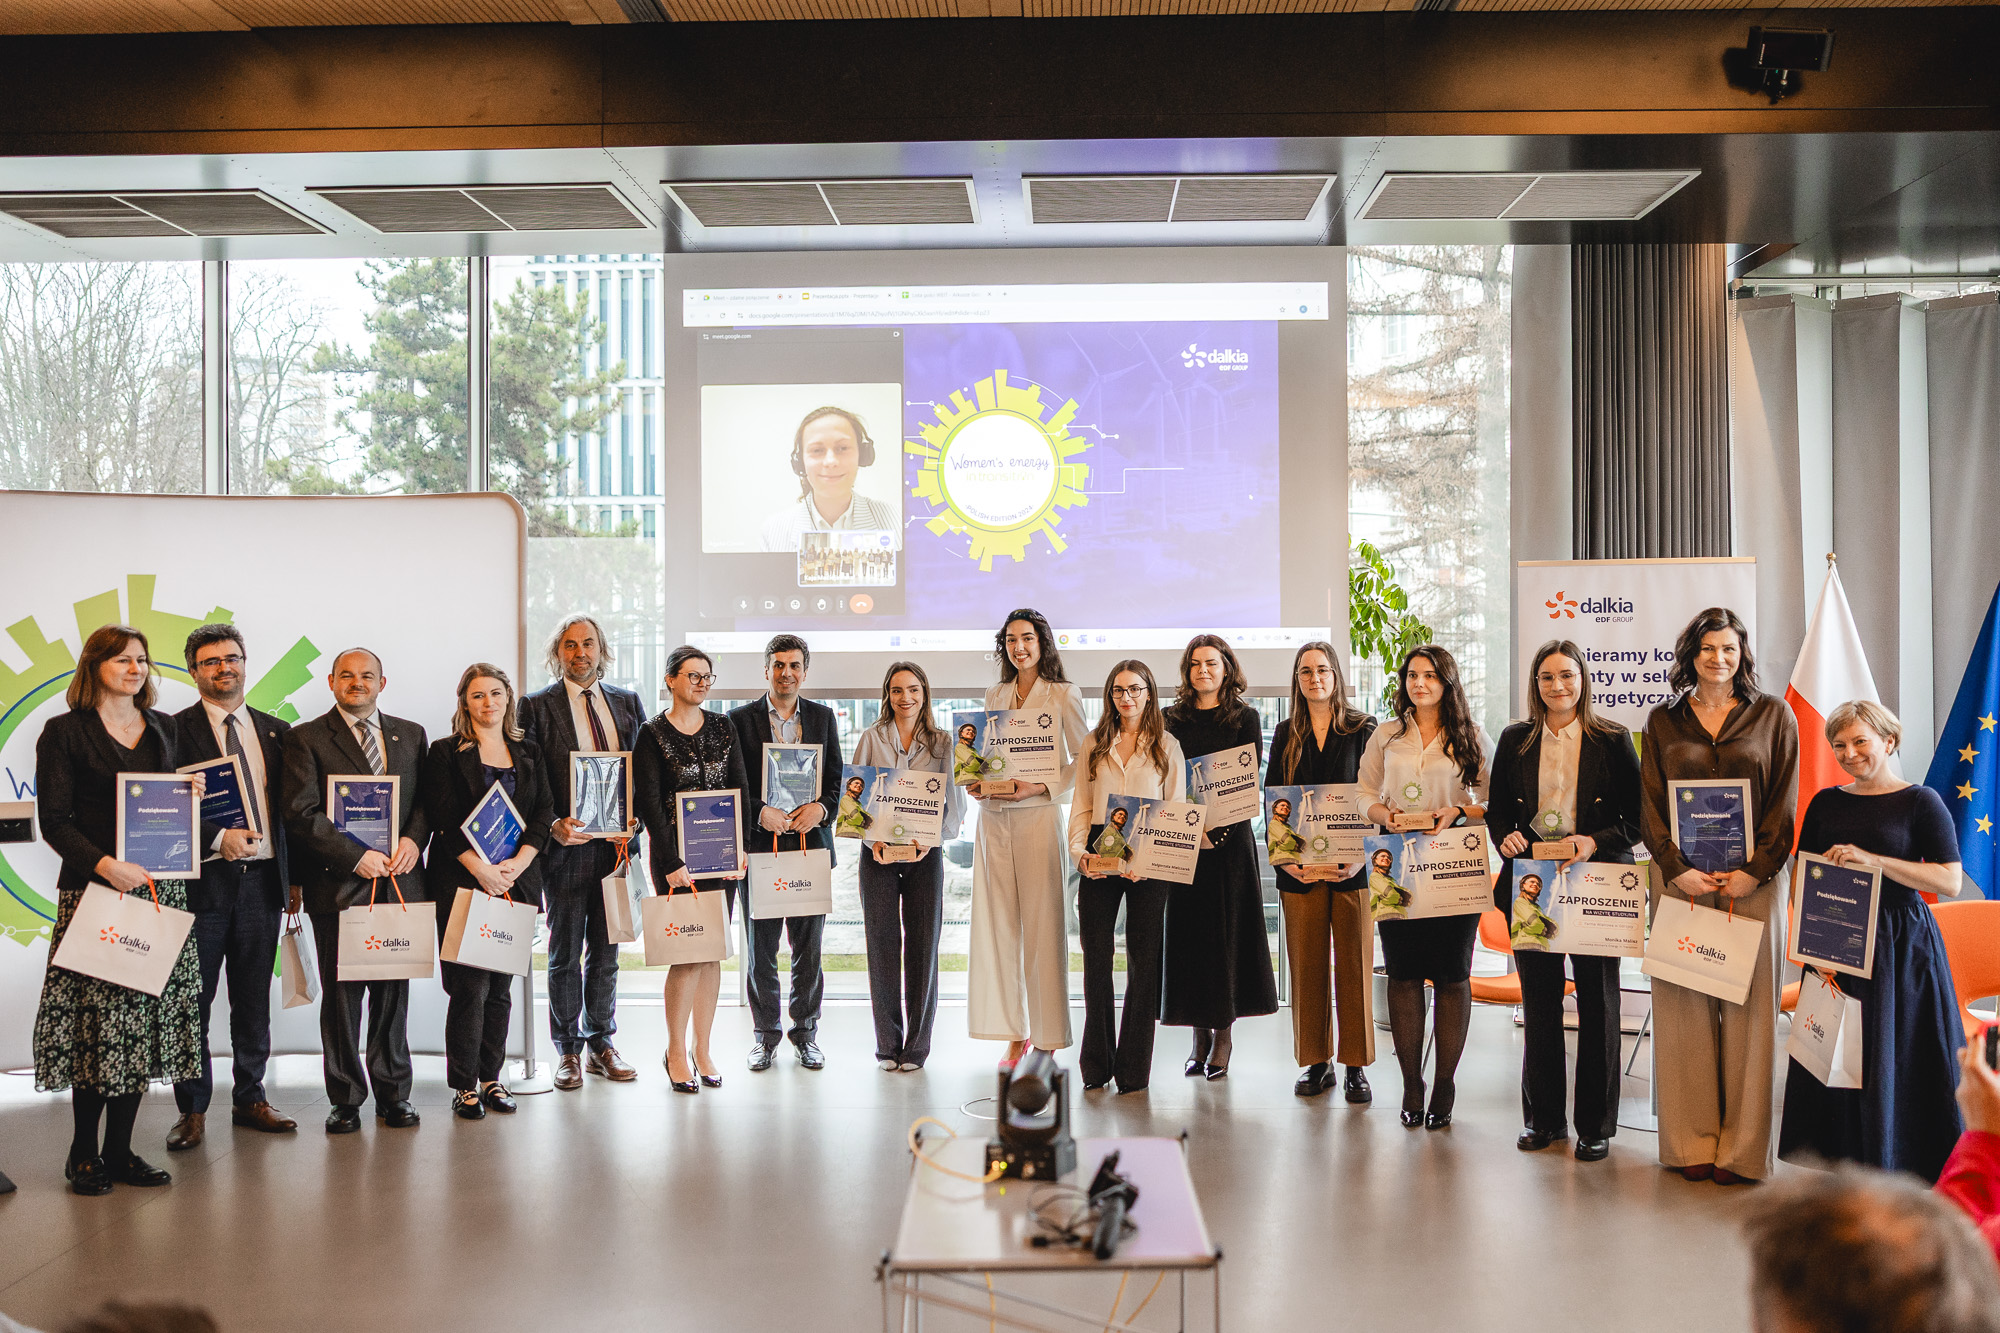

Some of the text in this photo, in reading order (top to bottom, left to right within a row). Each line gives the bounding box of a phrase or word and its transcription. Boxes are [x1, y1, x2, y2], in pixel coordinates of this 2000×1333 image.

[1207, 349, 1249, 364] dalkia
[950, 453, 1050, 471] Women's energy
[990, 514, 1018, 522] EDITION
[1018, 504, 1034, 518] 2024
[1580, 597, 1634, 614] dalkia
[1581, 647, 1675, 666] ieramy ko
[1621, 672, 1637, 683] w
[1643, 669, 1670, 683] sek
[1592, 691, 1677, 708] ergetyczn
[989, 735, 1054, 747] ZAPROSZENIE
[1198, 772, 1255, 793] ZAPROSZENIE
[875, 794, 940, 808] ZAPROSZENIE
[1305, 813, 1363, 822] ZAPROSZEN
[1137, 826, 1197, 842] ZAPROSZENIE
[1408, 858, 1484, 874] ZAPROSZENIE
[788, 879, 812, 889] dalkia
[1558, 895, 1639, 909] ZAPROSZENIE
[1816, 890, 1858, 905] Podziękowanie
[491, 929, 514, 942] dalkia
[680, 923, 704, 934] dalkia
[119, 934, 151, 953] dalkia
[382, 938, 410, 948] dalkia
[1695, 944, 1727, 961] dalkia
